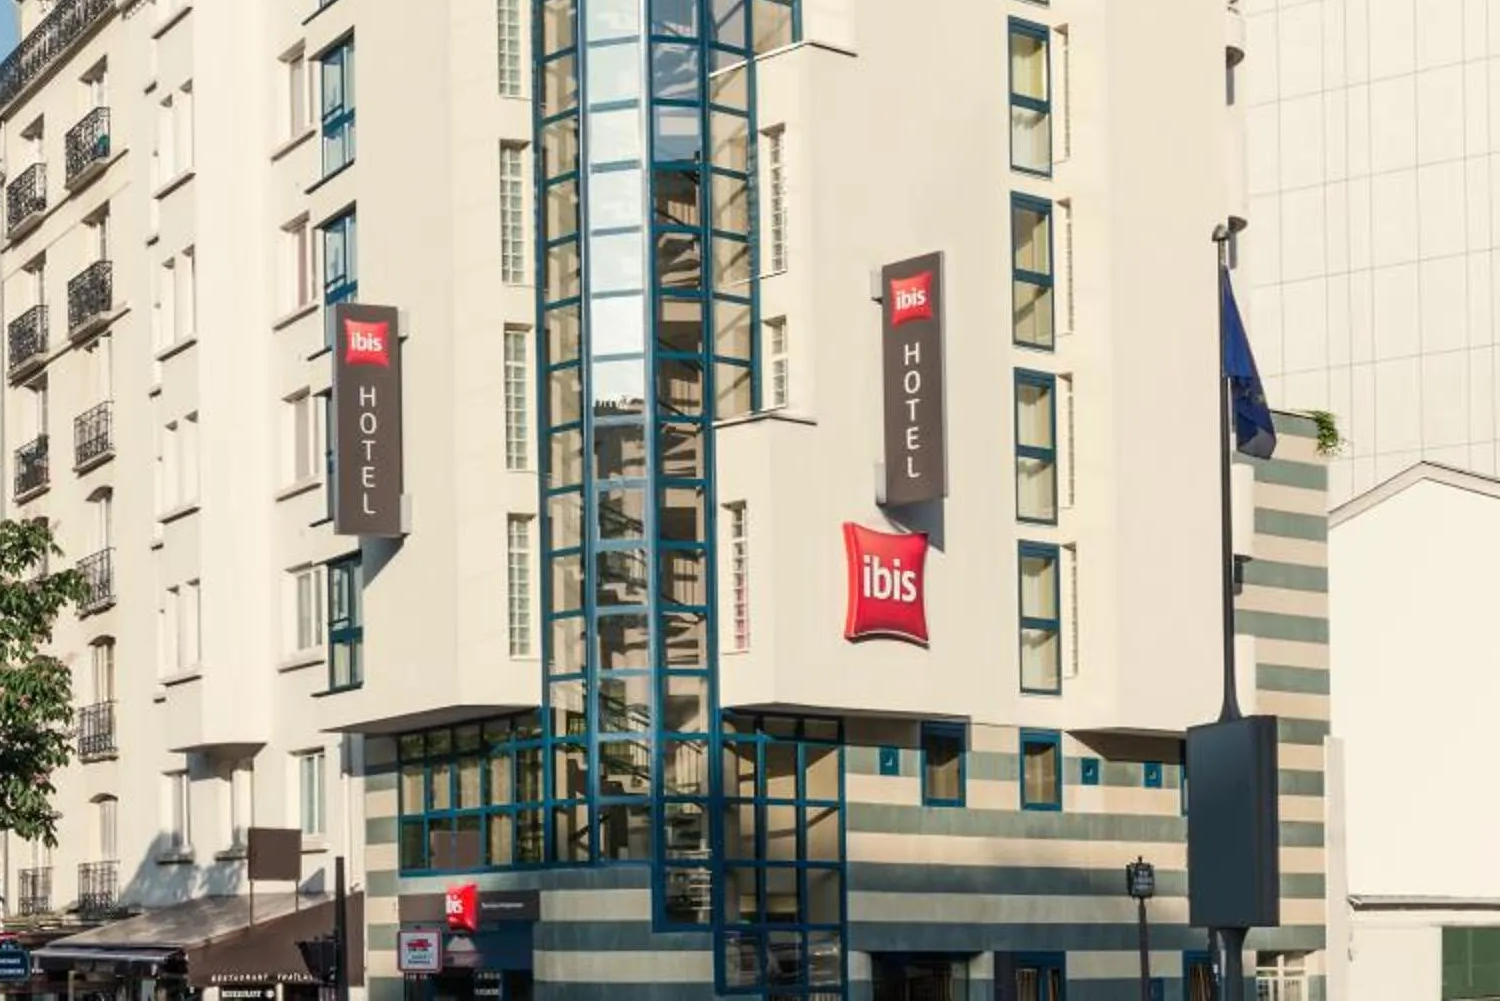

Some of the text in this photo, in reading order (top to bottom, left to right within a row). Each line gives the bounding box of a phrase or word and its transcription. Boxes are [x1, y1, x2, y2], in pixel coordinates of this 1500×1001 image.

[895, 288, 926, 312] ibis
[351, 332, 383, 351] ibis
[903, 342, 920, 479] HOTEL
[359, 385, 377, 515] HOTEL
[863, 554, 917, 602] ibis
